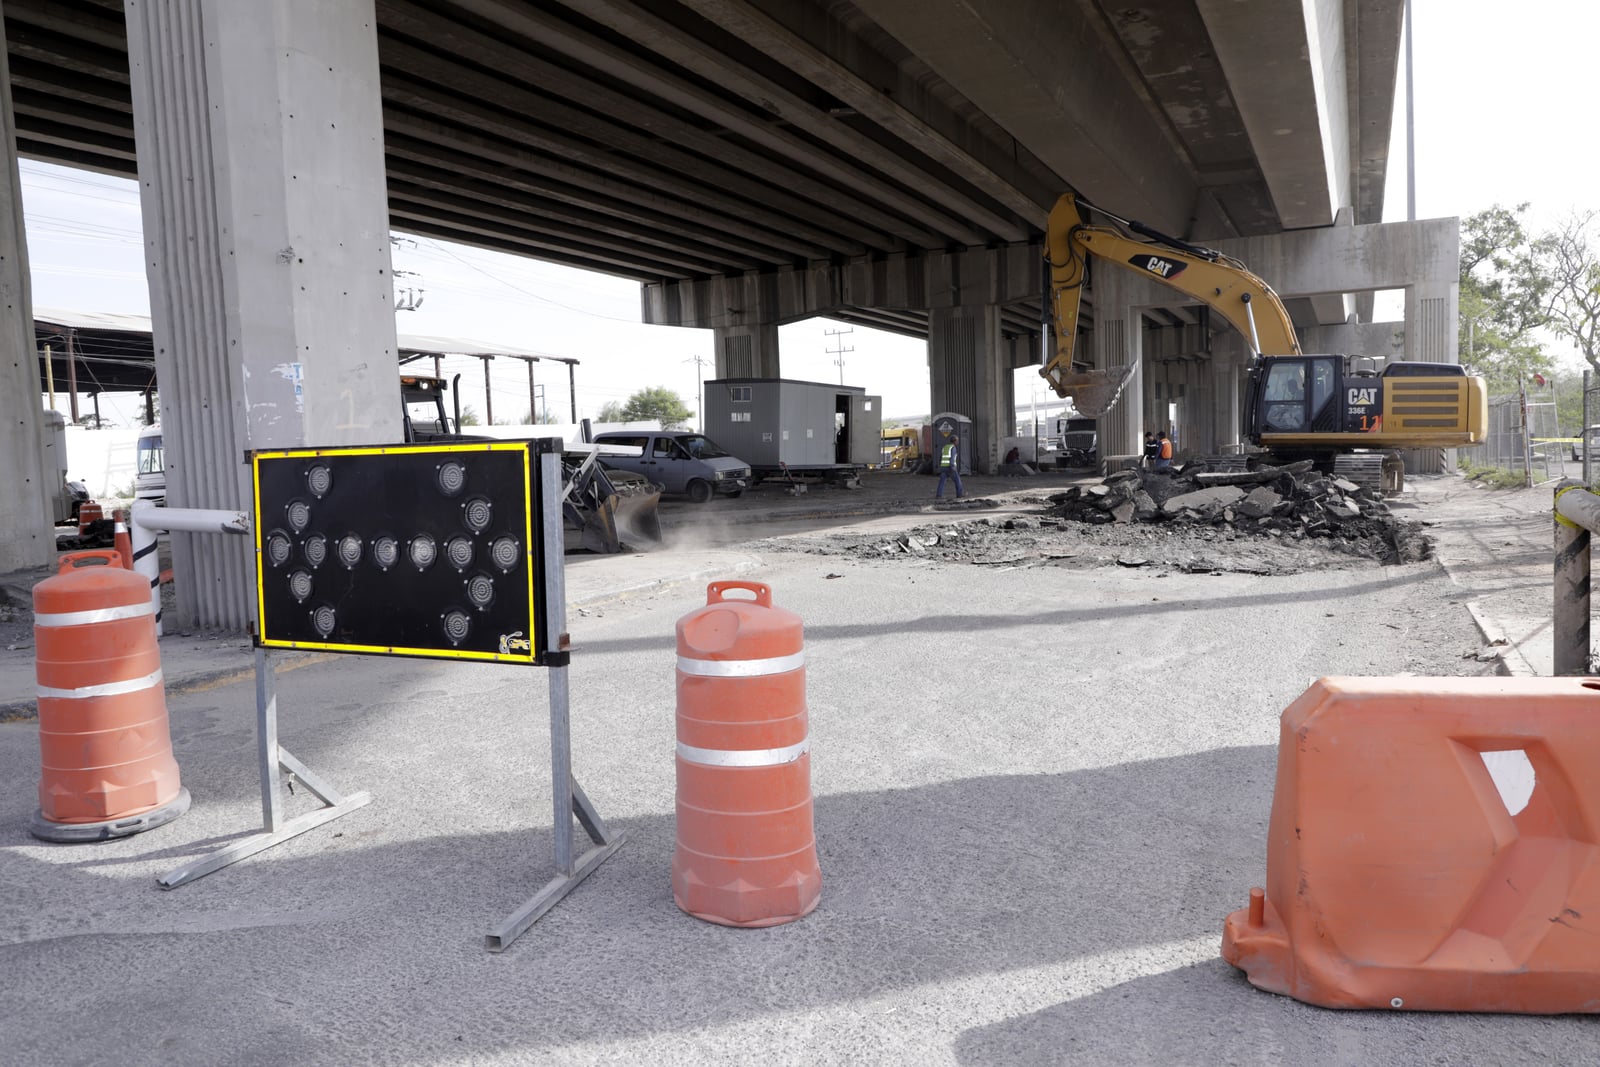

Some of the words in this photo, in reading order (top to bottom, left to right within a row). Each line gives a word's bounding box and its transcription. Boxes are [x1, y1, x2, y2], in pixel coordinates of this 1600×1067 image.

[1147, 257, 1172, 277] CAT
[1348, 388, 1378, 405] CAT
[1360, 415, 1379, 430] 11
